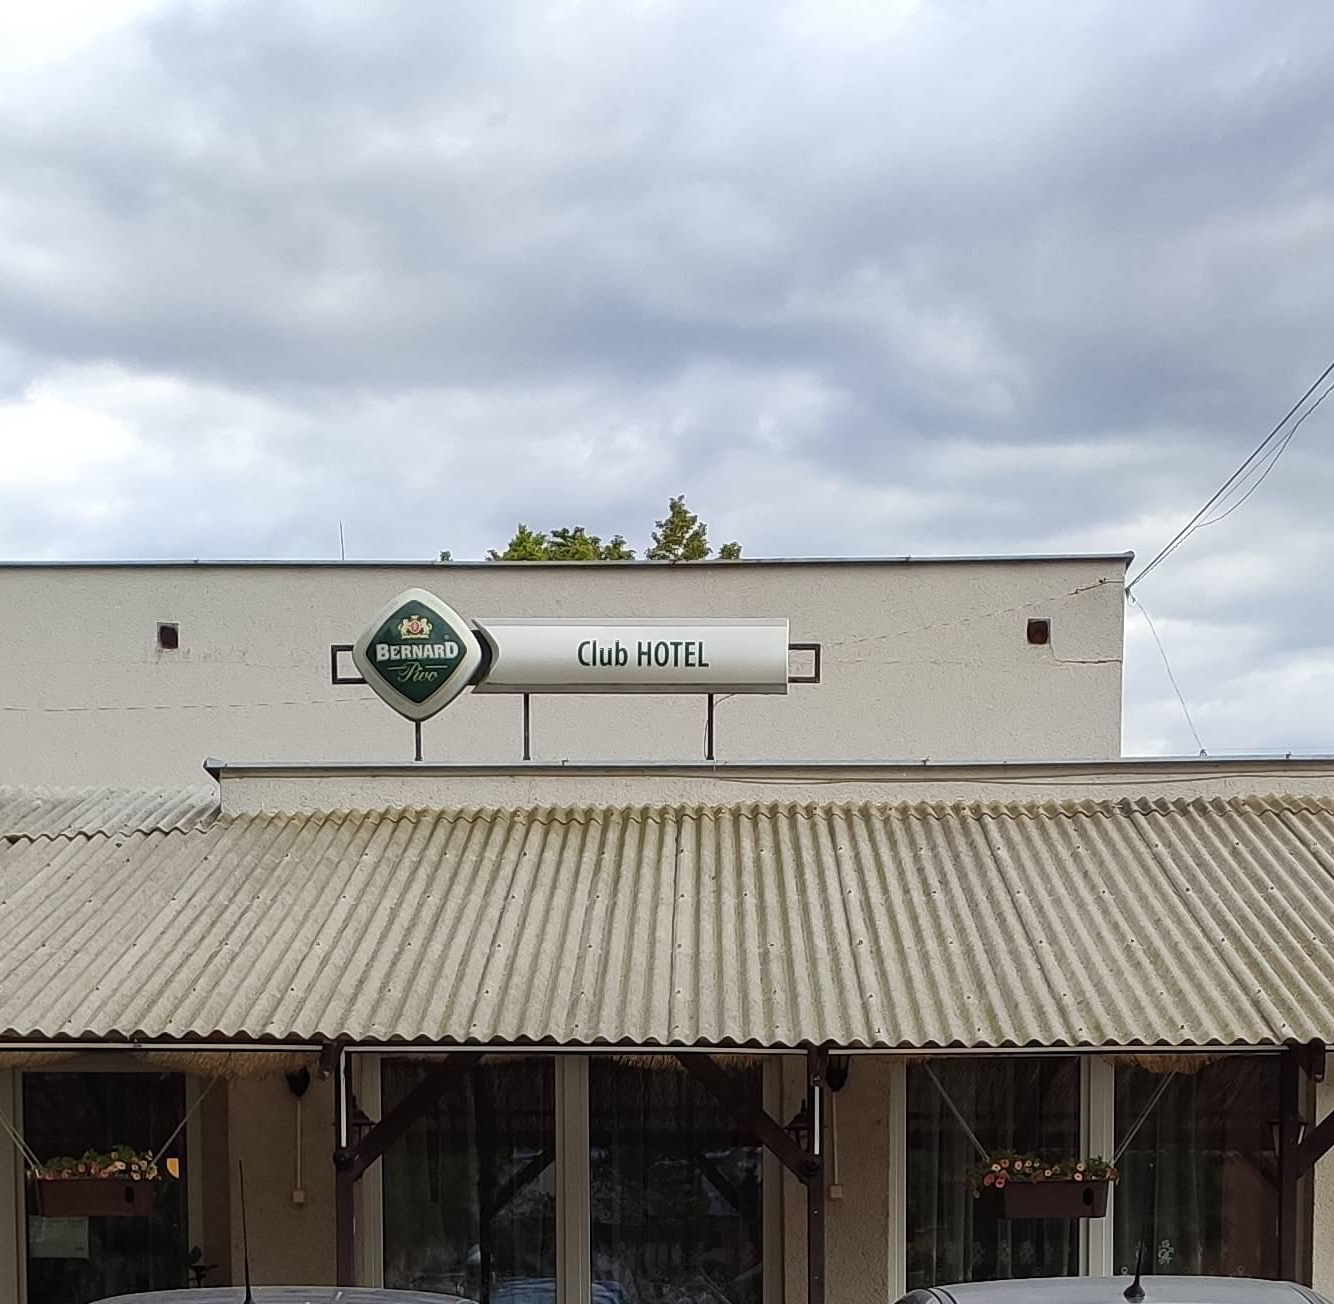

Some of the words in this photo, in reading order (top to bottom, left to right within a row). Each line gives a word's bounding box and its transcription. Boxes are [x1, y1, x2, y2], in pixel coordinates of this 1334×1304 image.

[376, 641, 459, 662] BERNARD
[577, 640, 628, 667] Club
[637, 641, 709, 667] HOTEL
[397, 662, 439, 682] Pivo
